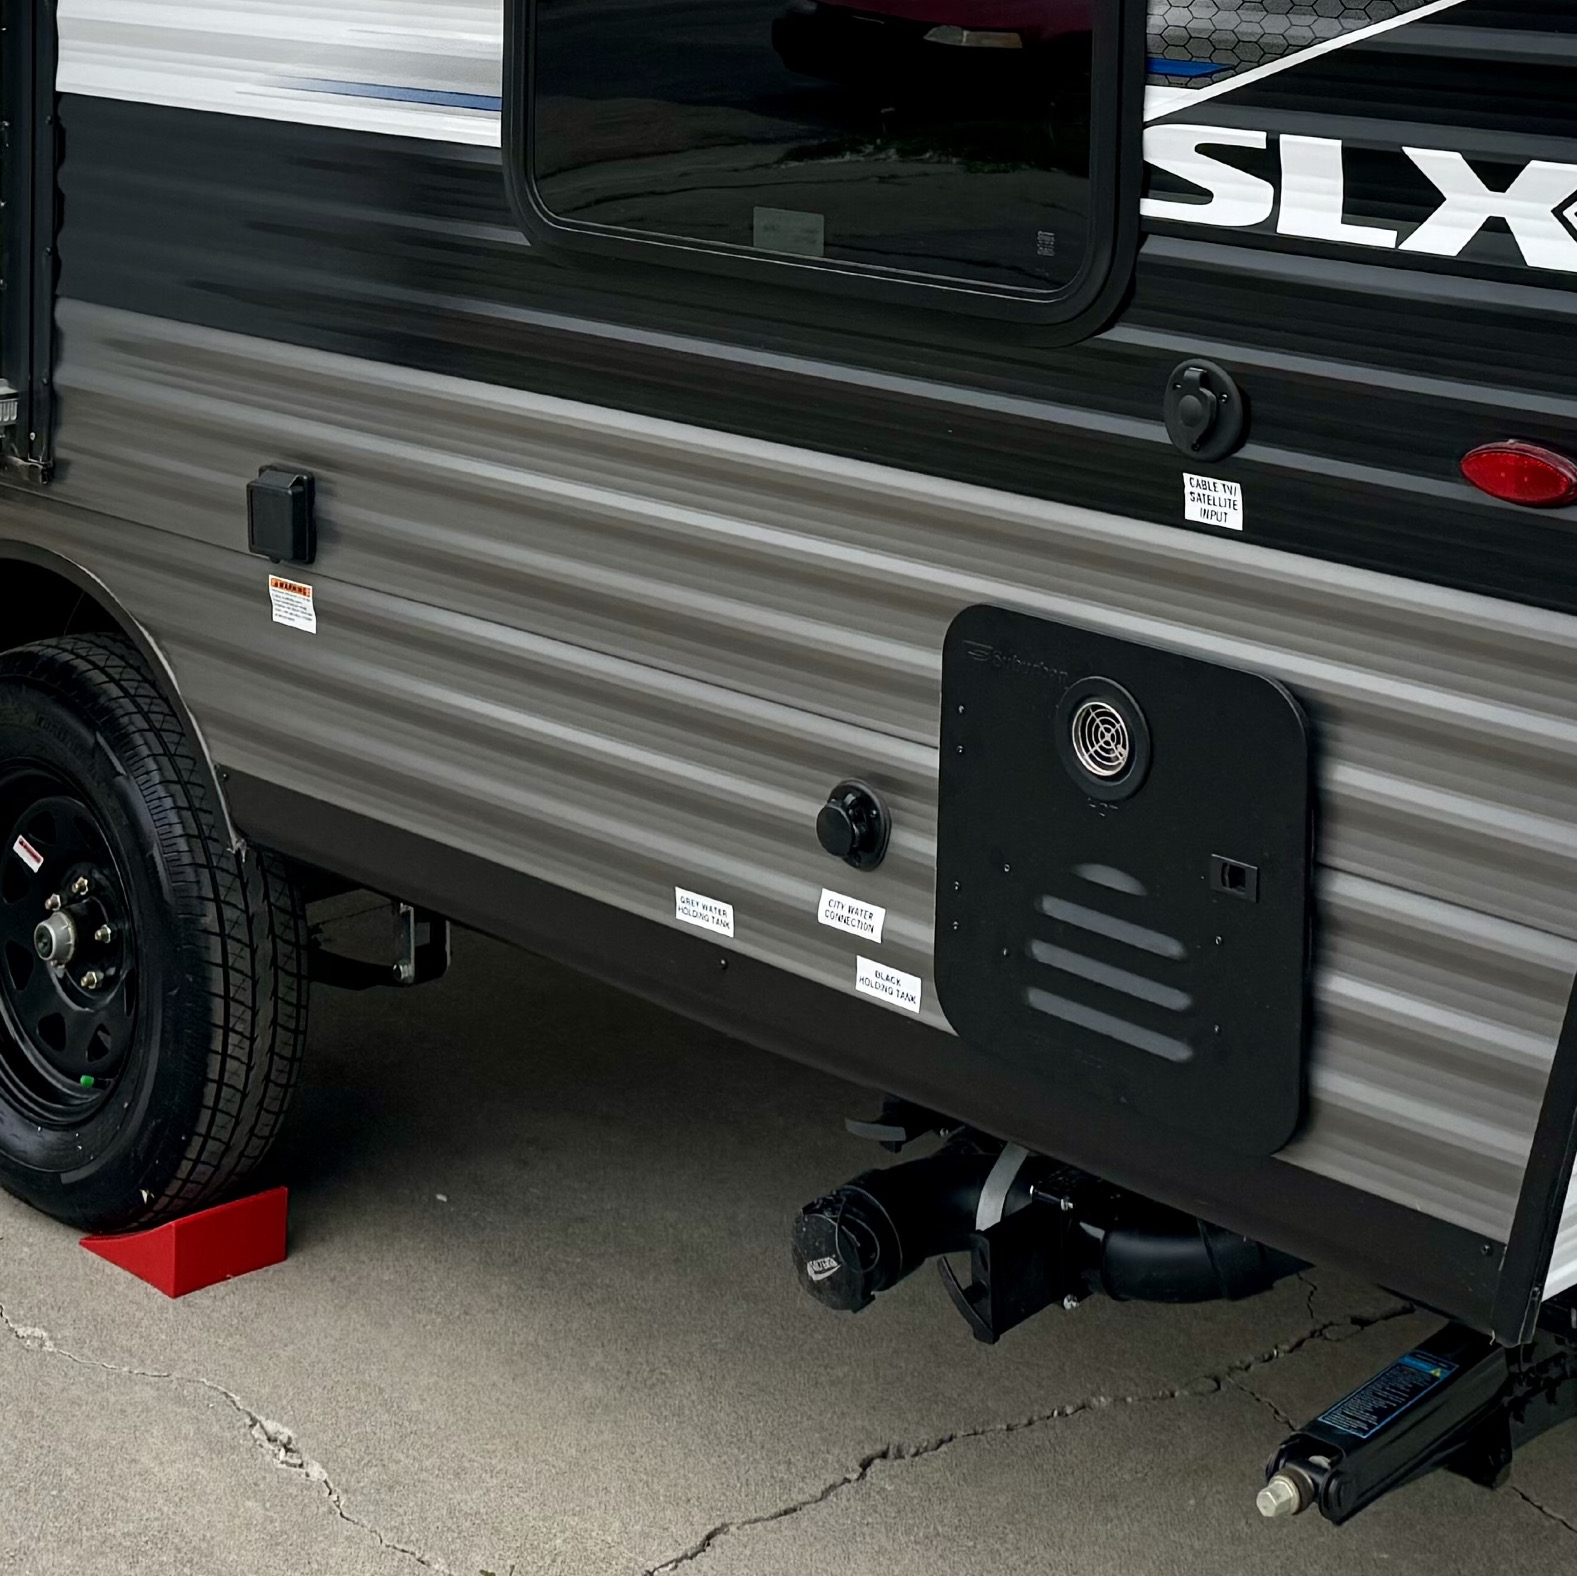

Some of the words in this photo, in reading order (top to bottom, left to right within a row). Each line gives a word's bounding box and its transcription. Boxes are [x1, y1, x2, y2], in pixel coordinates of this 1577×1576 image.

[1189, 476, 1219, 493] CABLE
[1189, 491, 1239, 511] SATELLITE
[1200, 507, 1228, 523] INPUT
[678, 905, 710, 923] HOLDING
[711, 915, 730, 930] TANK
[702, 903, 728, 918] WATER
[828, 898, 845, 911] CITY
[848, 905, 874, 921] WATER
[824, 909, 875, 934] CONNECTION
[874, 970, 901, 987] BLACK
[858, 976, 894, 996] HOLDING
[896, 988, 917, 1004] TANK
